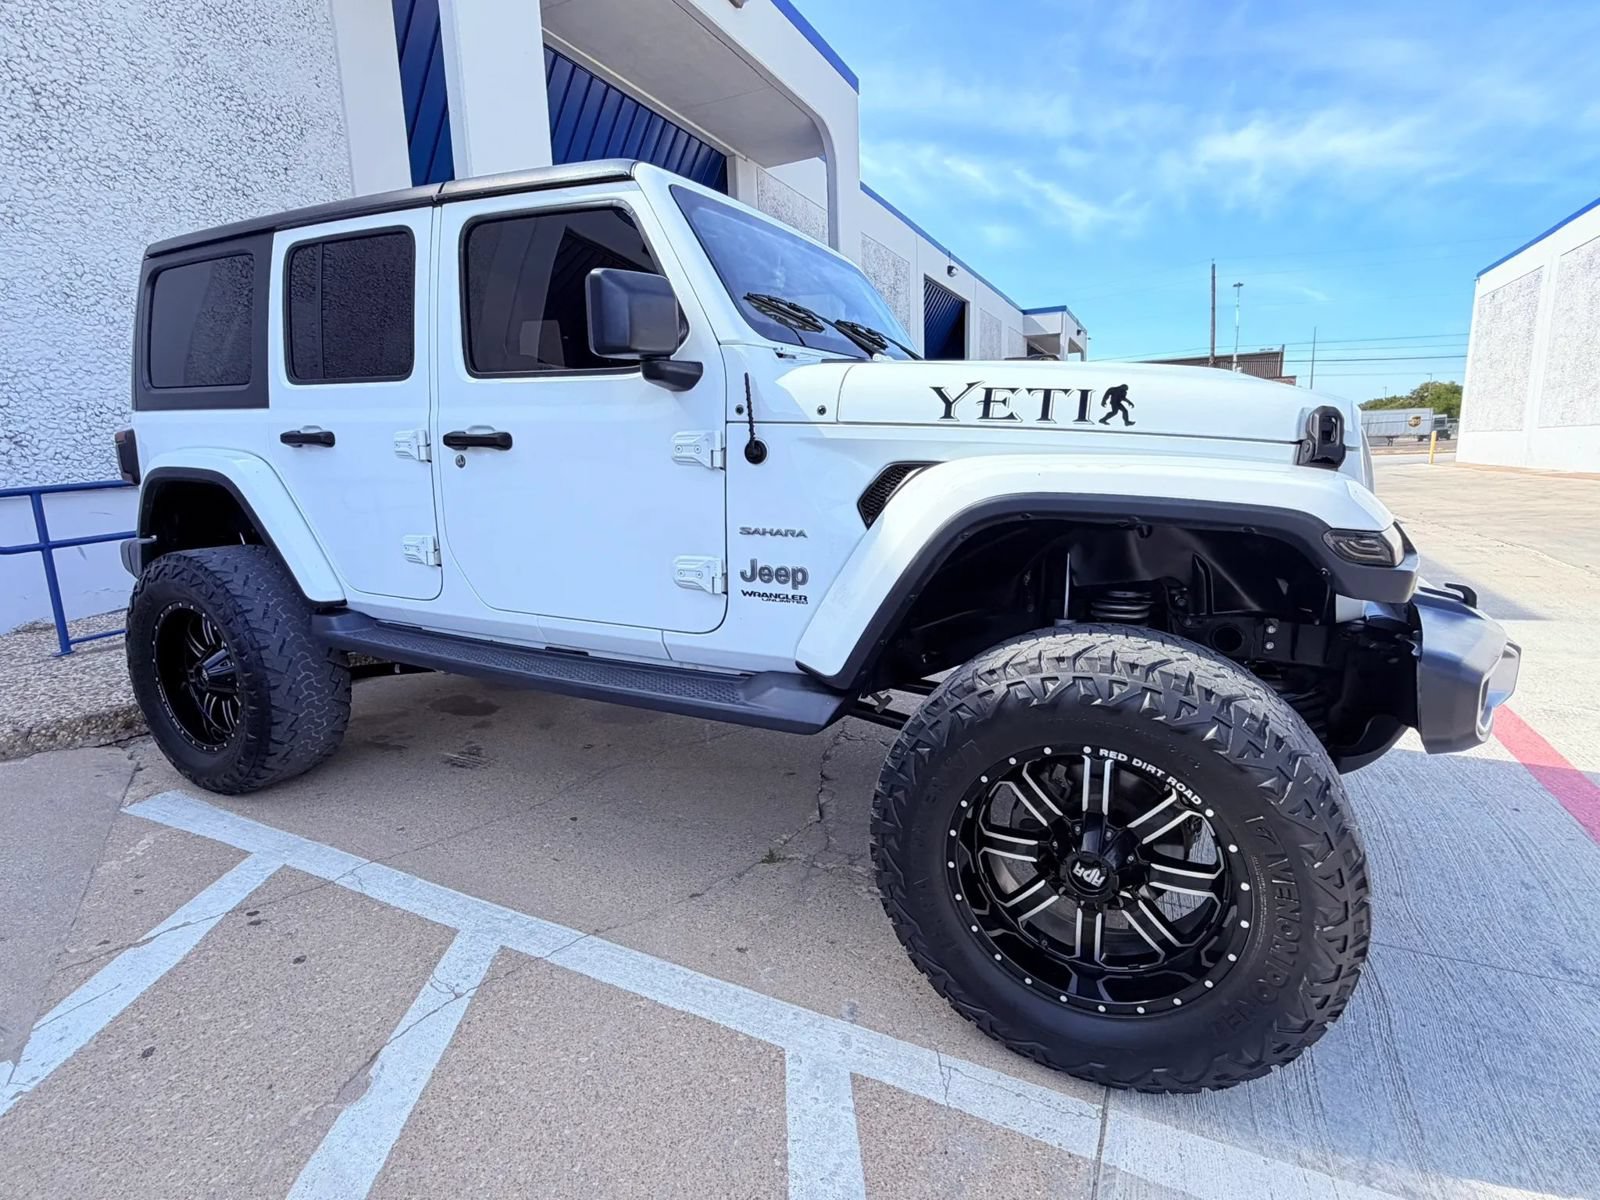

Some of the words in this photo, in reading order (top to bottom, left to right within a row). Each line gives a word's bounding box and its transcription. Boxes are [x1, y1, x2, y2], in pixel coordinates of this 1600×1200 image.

[929, 380, 1095, 424] YETI
[739, 527, 808, 538] SAHARA
[740, 559, 809, 590] Jeep
[741, 590, 808, 601] WRANGLER
[1099, 748, 1128, 761] RED
[1132, 758, 1165, 777] DIRT
[1166, 776, 1202, 805] ROAD
[1266, 856, 1300, 967] VENOM
